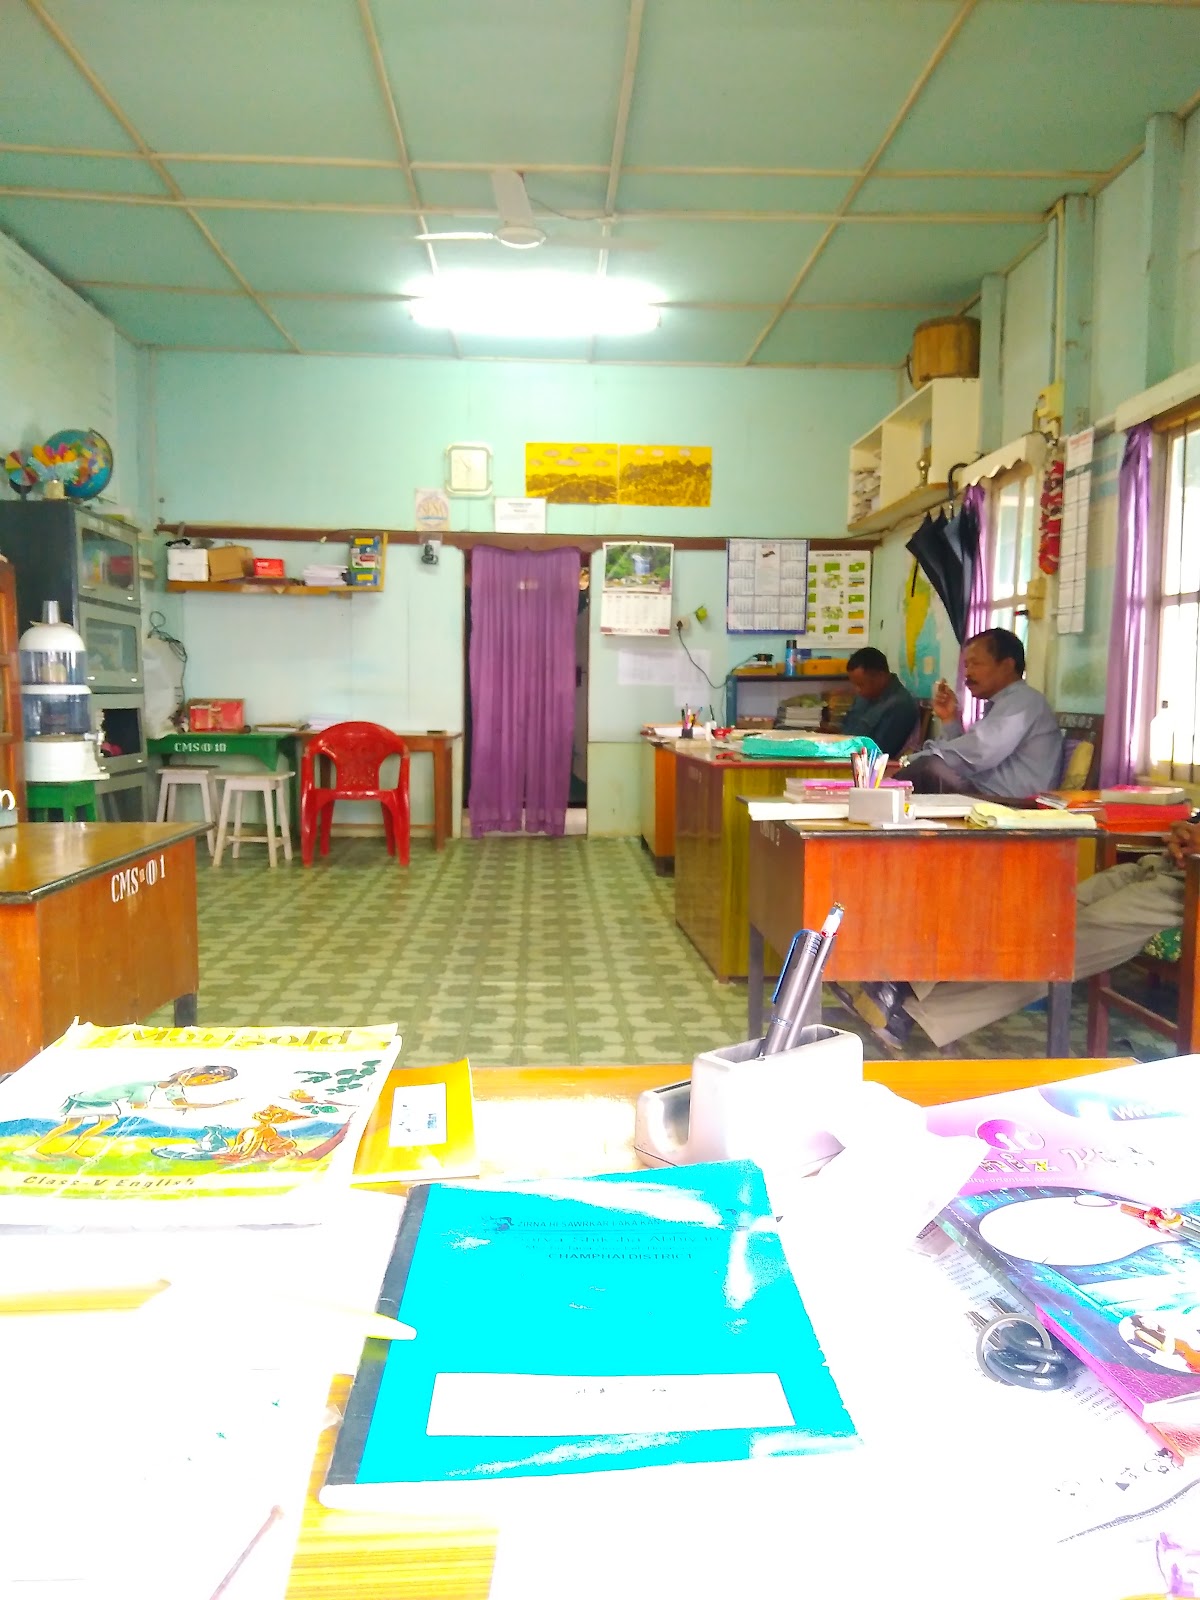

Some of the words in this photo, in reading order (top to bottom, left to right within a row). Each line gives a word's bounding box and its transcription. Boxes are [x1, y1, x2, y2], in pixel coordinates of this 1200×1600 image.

[117, 1028, 353, 1048] Marigold
[115, 1178, 195, 1189] English
[628, 1252, 693, 1260] DISTRICT
